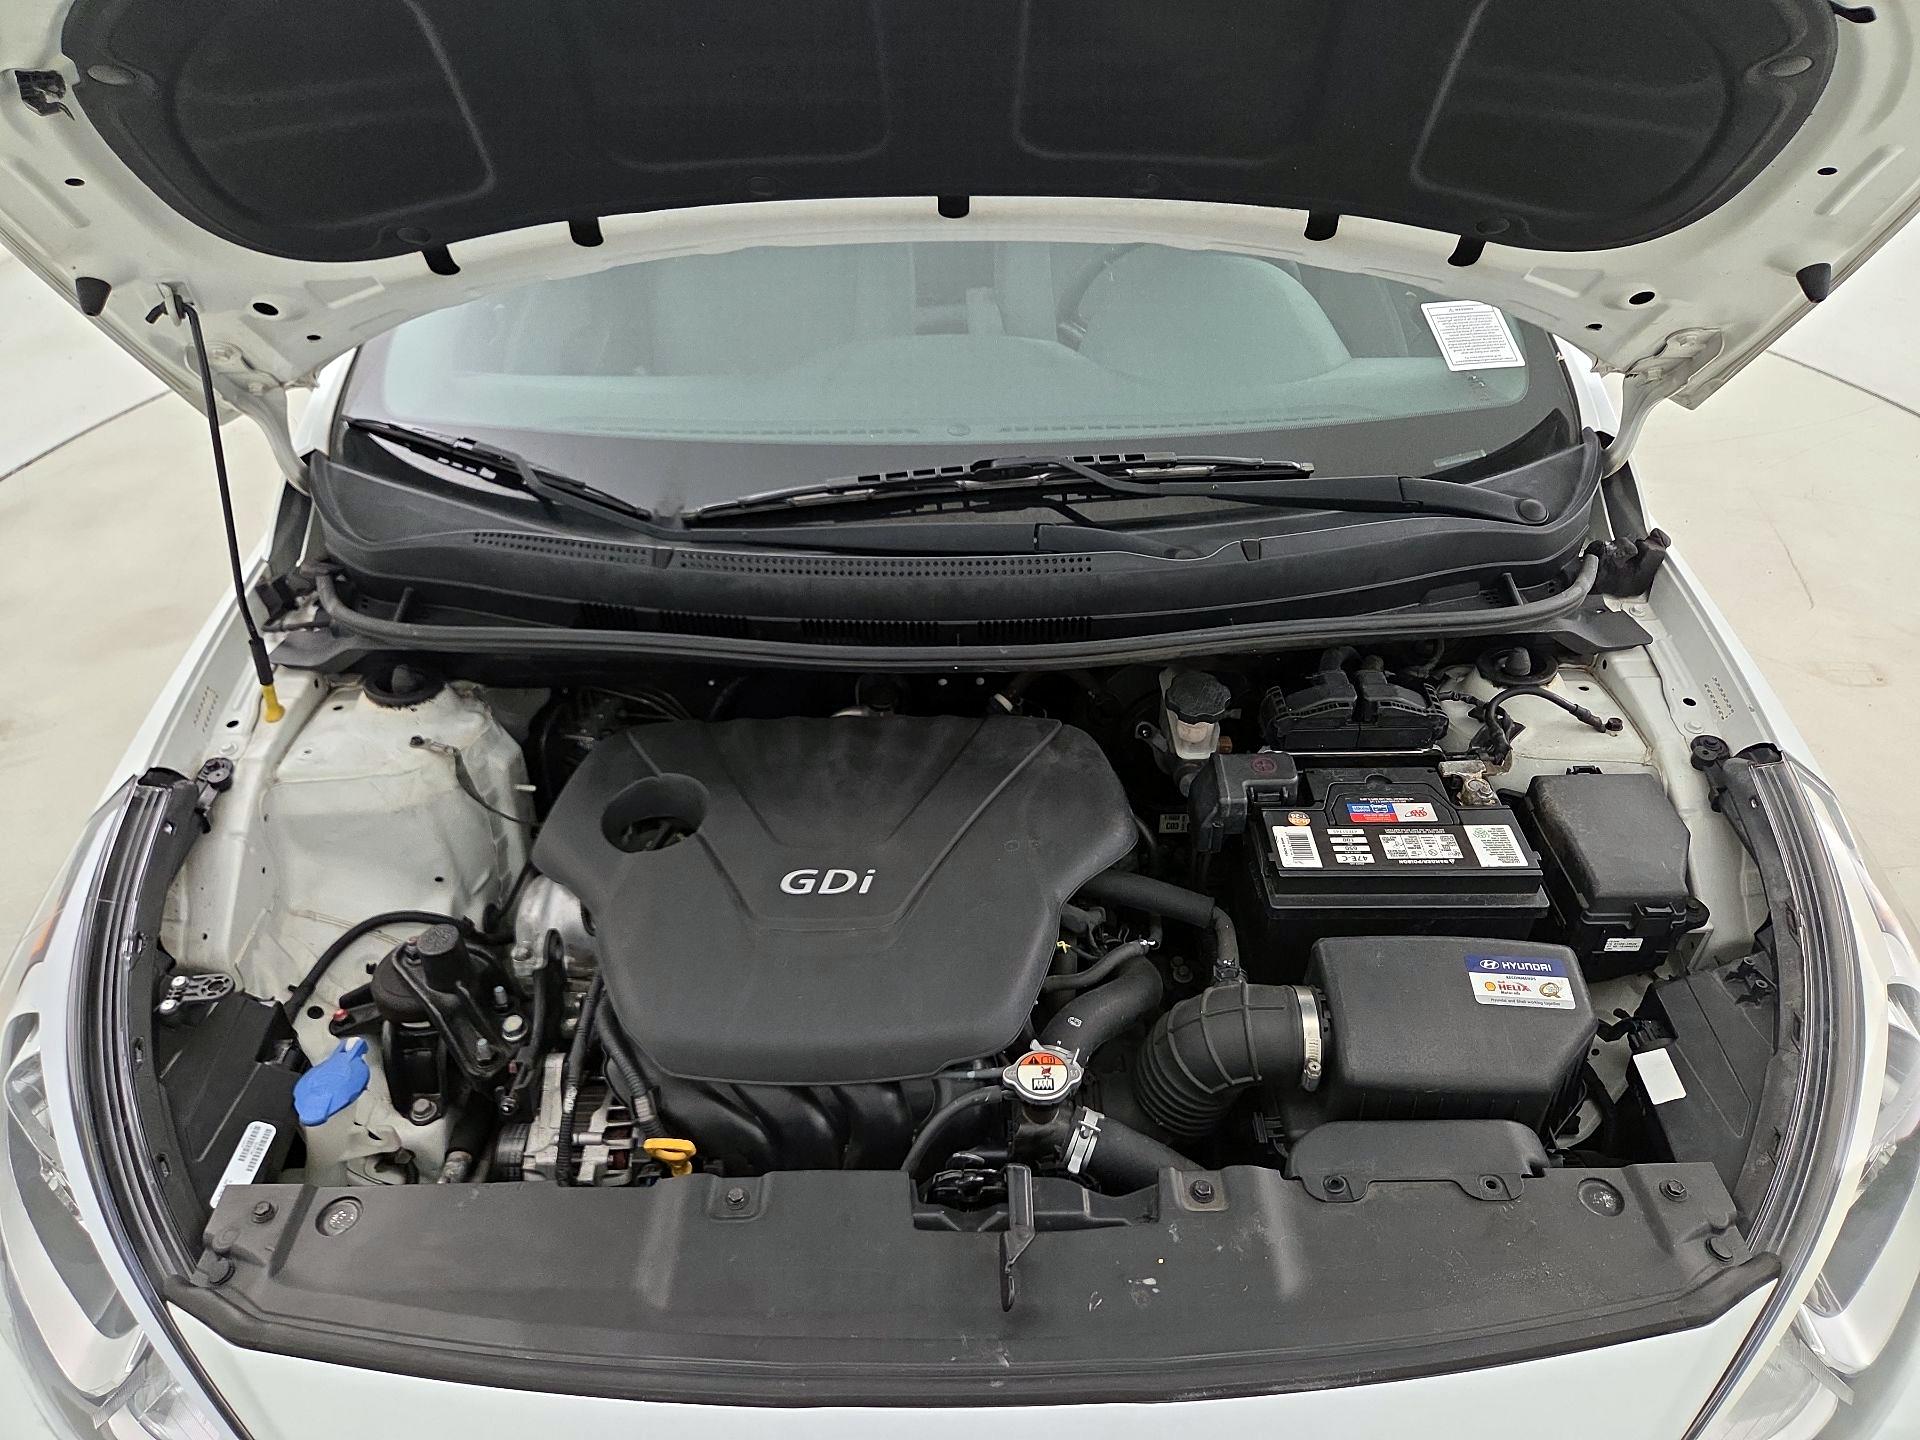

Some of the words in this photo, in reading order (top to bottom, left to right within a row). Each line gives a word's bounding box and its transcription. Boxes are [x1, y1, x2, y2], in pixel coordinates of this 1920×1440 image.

[780, 868, 876, 895] GDi
[1501, 961, 1552, 972] HYUNDAI
[1498, 983, 1531, 992] HELIX
